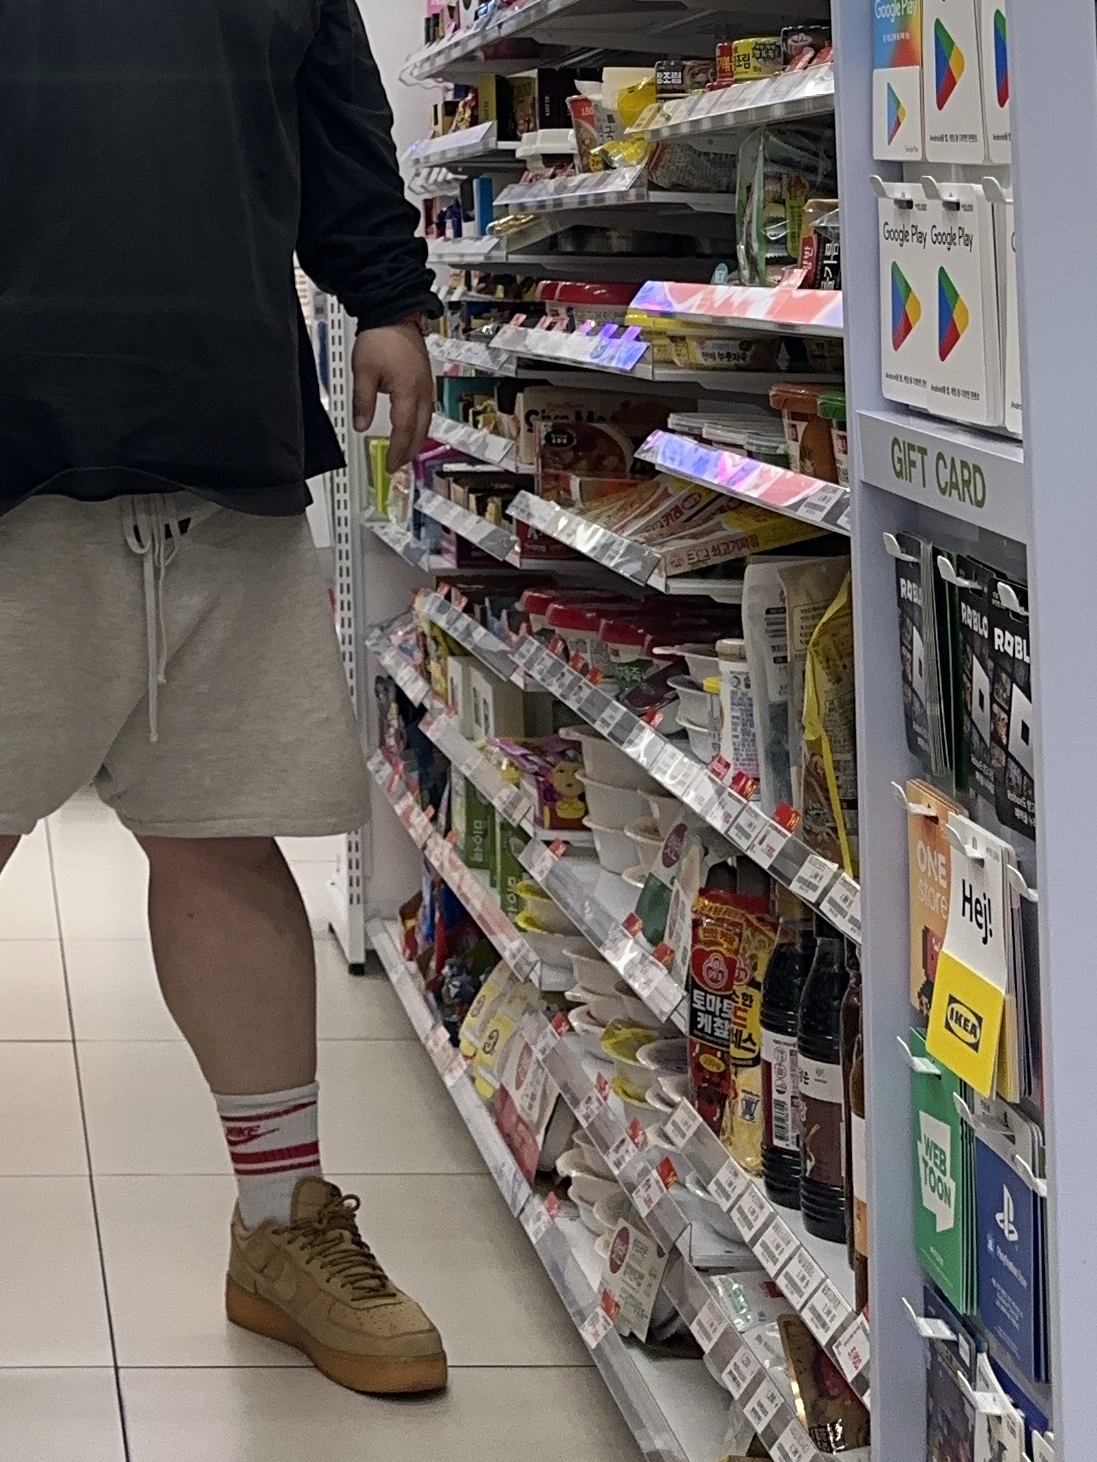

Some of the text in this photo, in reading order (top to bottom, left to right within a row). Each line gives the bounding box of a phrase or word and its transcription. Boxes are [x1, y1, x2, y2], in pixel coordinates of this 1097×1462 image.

[883, 221, 927, 249] Google Play
[930, 226, 974, 253] Google Play
[891, 436, 987, 509] GIFT CARD
[915, 840, 947, 889] ONE
[916, 879, 949, 921] store
[961, 878, 993, 946] Hej!
[949, 1004, 979, 1039] IKEA
[924, 1136, 947, 1177] WEB
[921, 1161, 952, 1208] TOON
